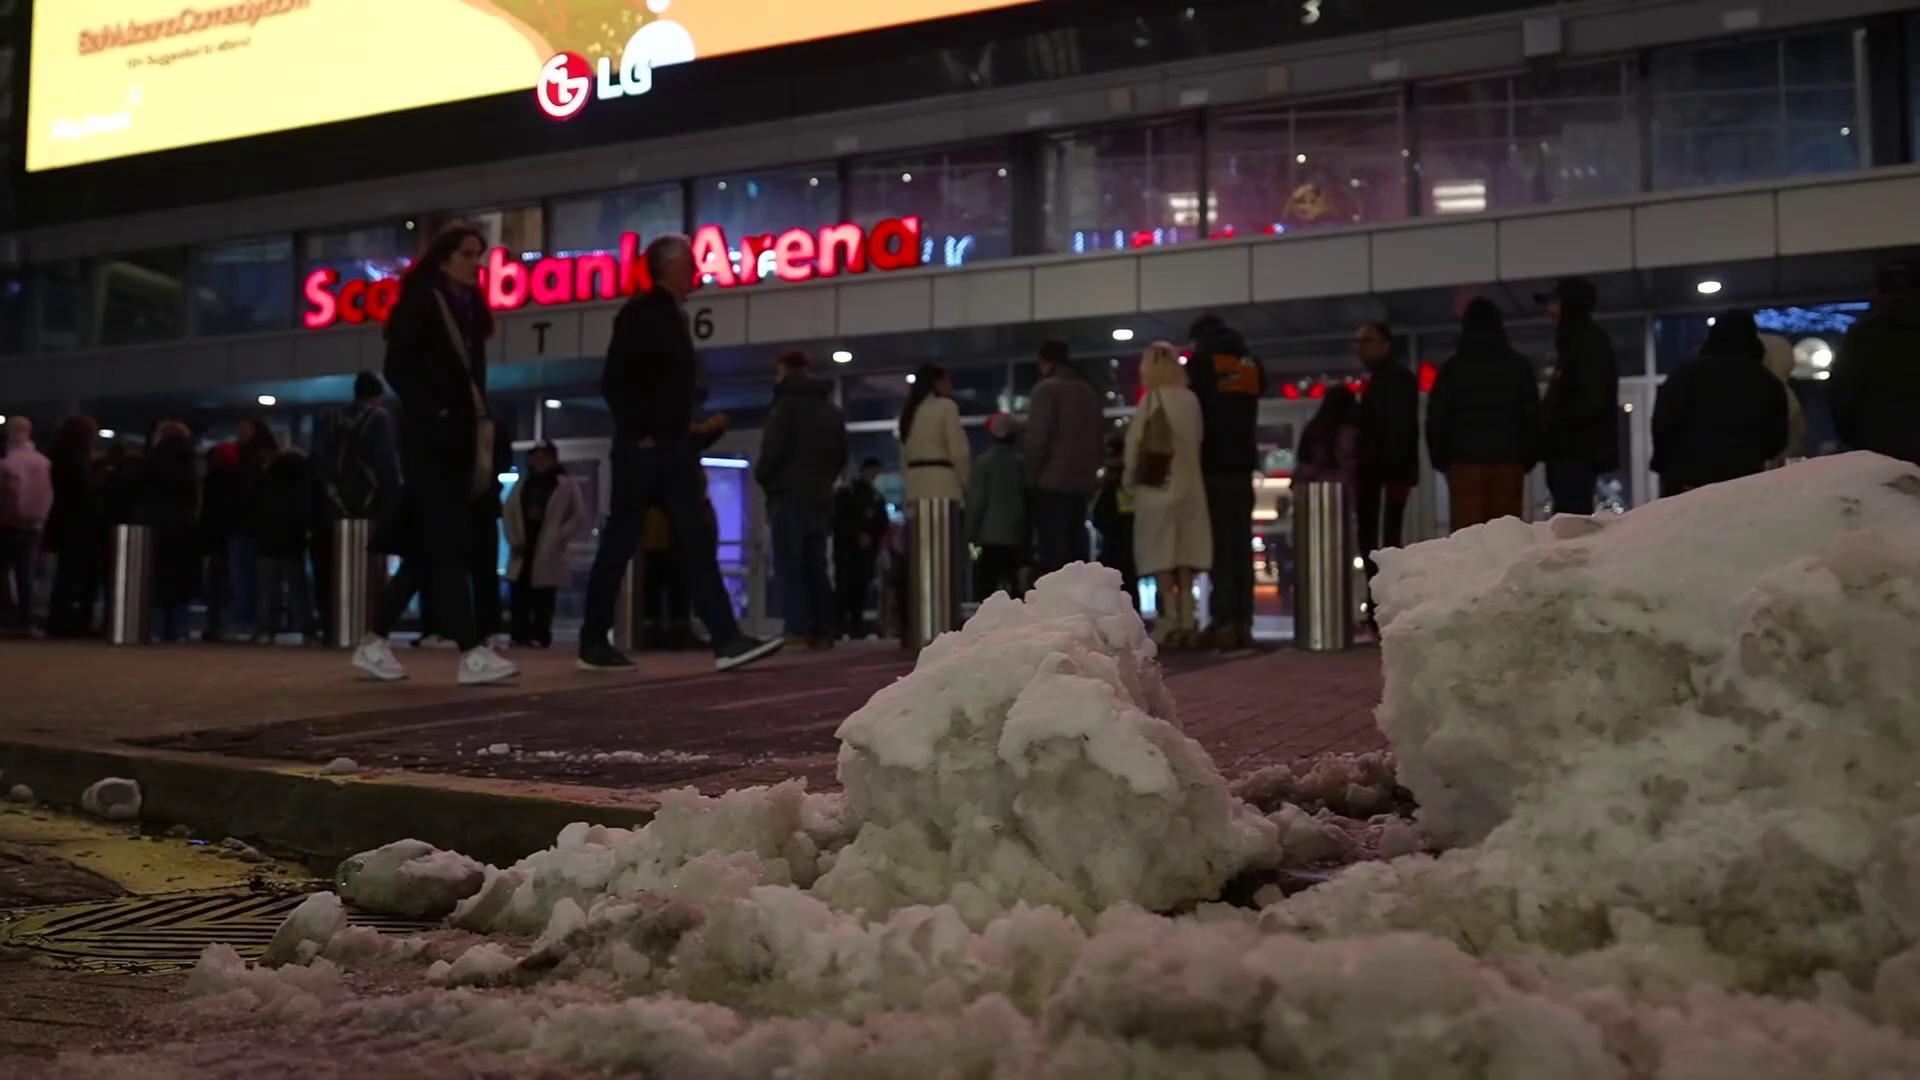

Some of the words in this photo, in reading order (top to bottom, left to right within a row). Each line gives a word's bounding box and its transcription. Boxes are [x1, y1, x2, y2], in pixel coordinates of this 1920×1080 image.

[597, 57, 653, 100] LG
[303, 231, 652, 329] Scobank
[690, 215, 922, 288] Arena
[693, 307, 715, 340] 6
